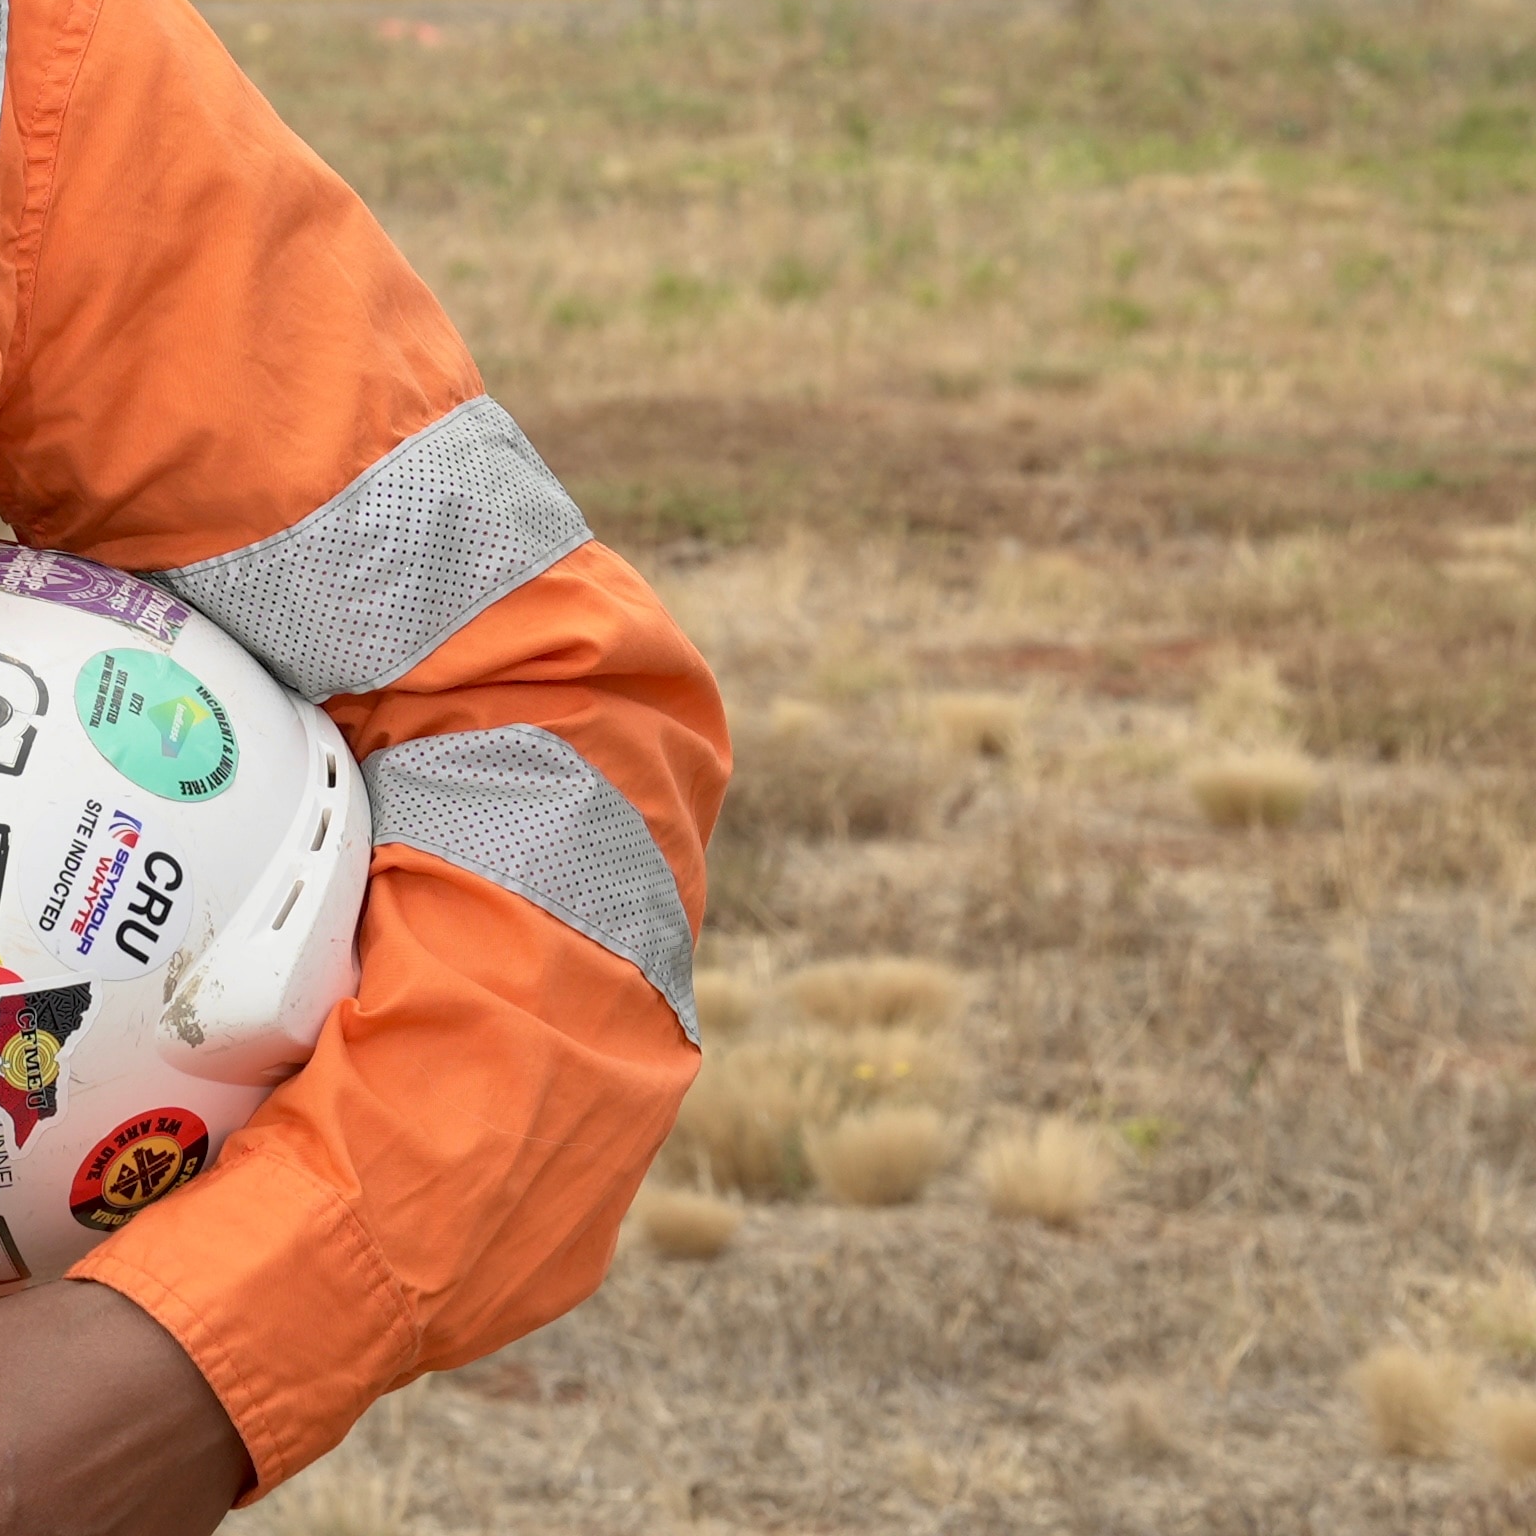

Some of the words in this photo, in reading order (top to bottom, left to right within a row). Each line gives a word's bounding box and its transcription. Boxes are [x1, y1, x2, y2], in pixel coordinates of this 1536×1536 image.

[114, 669, 128, 686] SITE
[105, 686, 125, 725] INDUCTED
[127, 692, 144, 717] 0721
[194, 685, 235, 748] INCIDENT
[221, 744, 233, 757] &
[177, 780, 208, 797] FREE
[205, 755, 234, 792] INJURY
[75, 799, 102, 839] SITE
[38, 839, 88, 932] INDUCTED
[69, 856, 112, 937] WHYTE
[75, 848, 130, 957] SEYMOUR
[114, 851, 183, 966] CRU
[14, 1008, 47, 1111] CFMEU
[112, 1119, 152, 1149] ARE
[154, 1117, 182, 1137] WE
[85, 1146, 116, 1182] ONE
